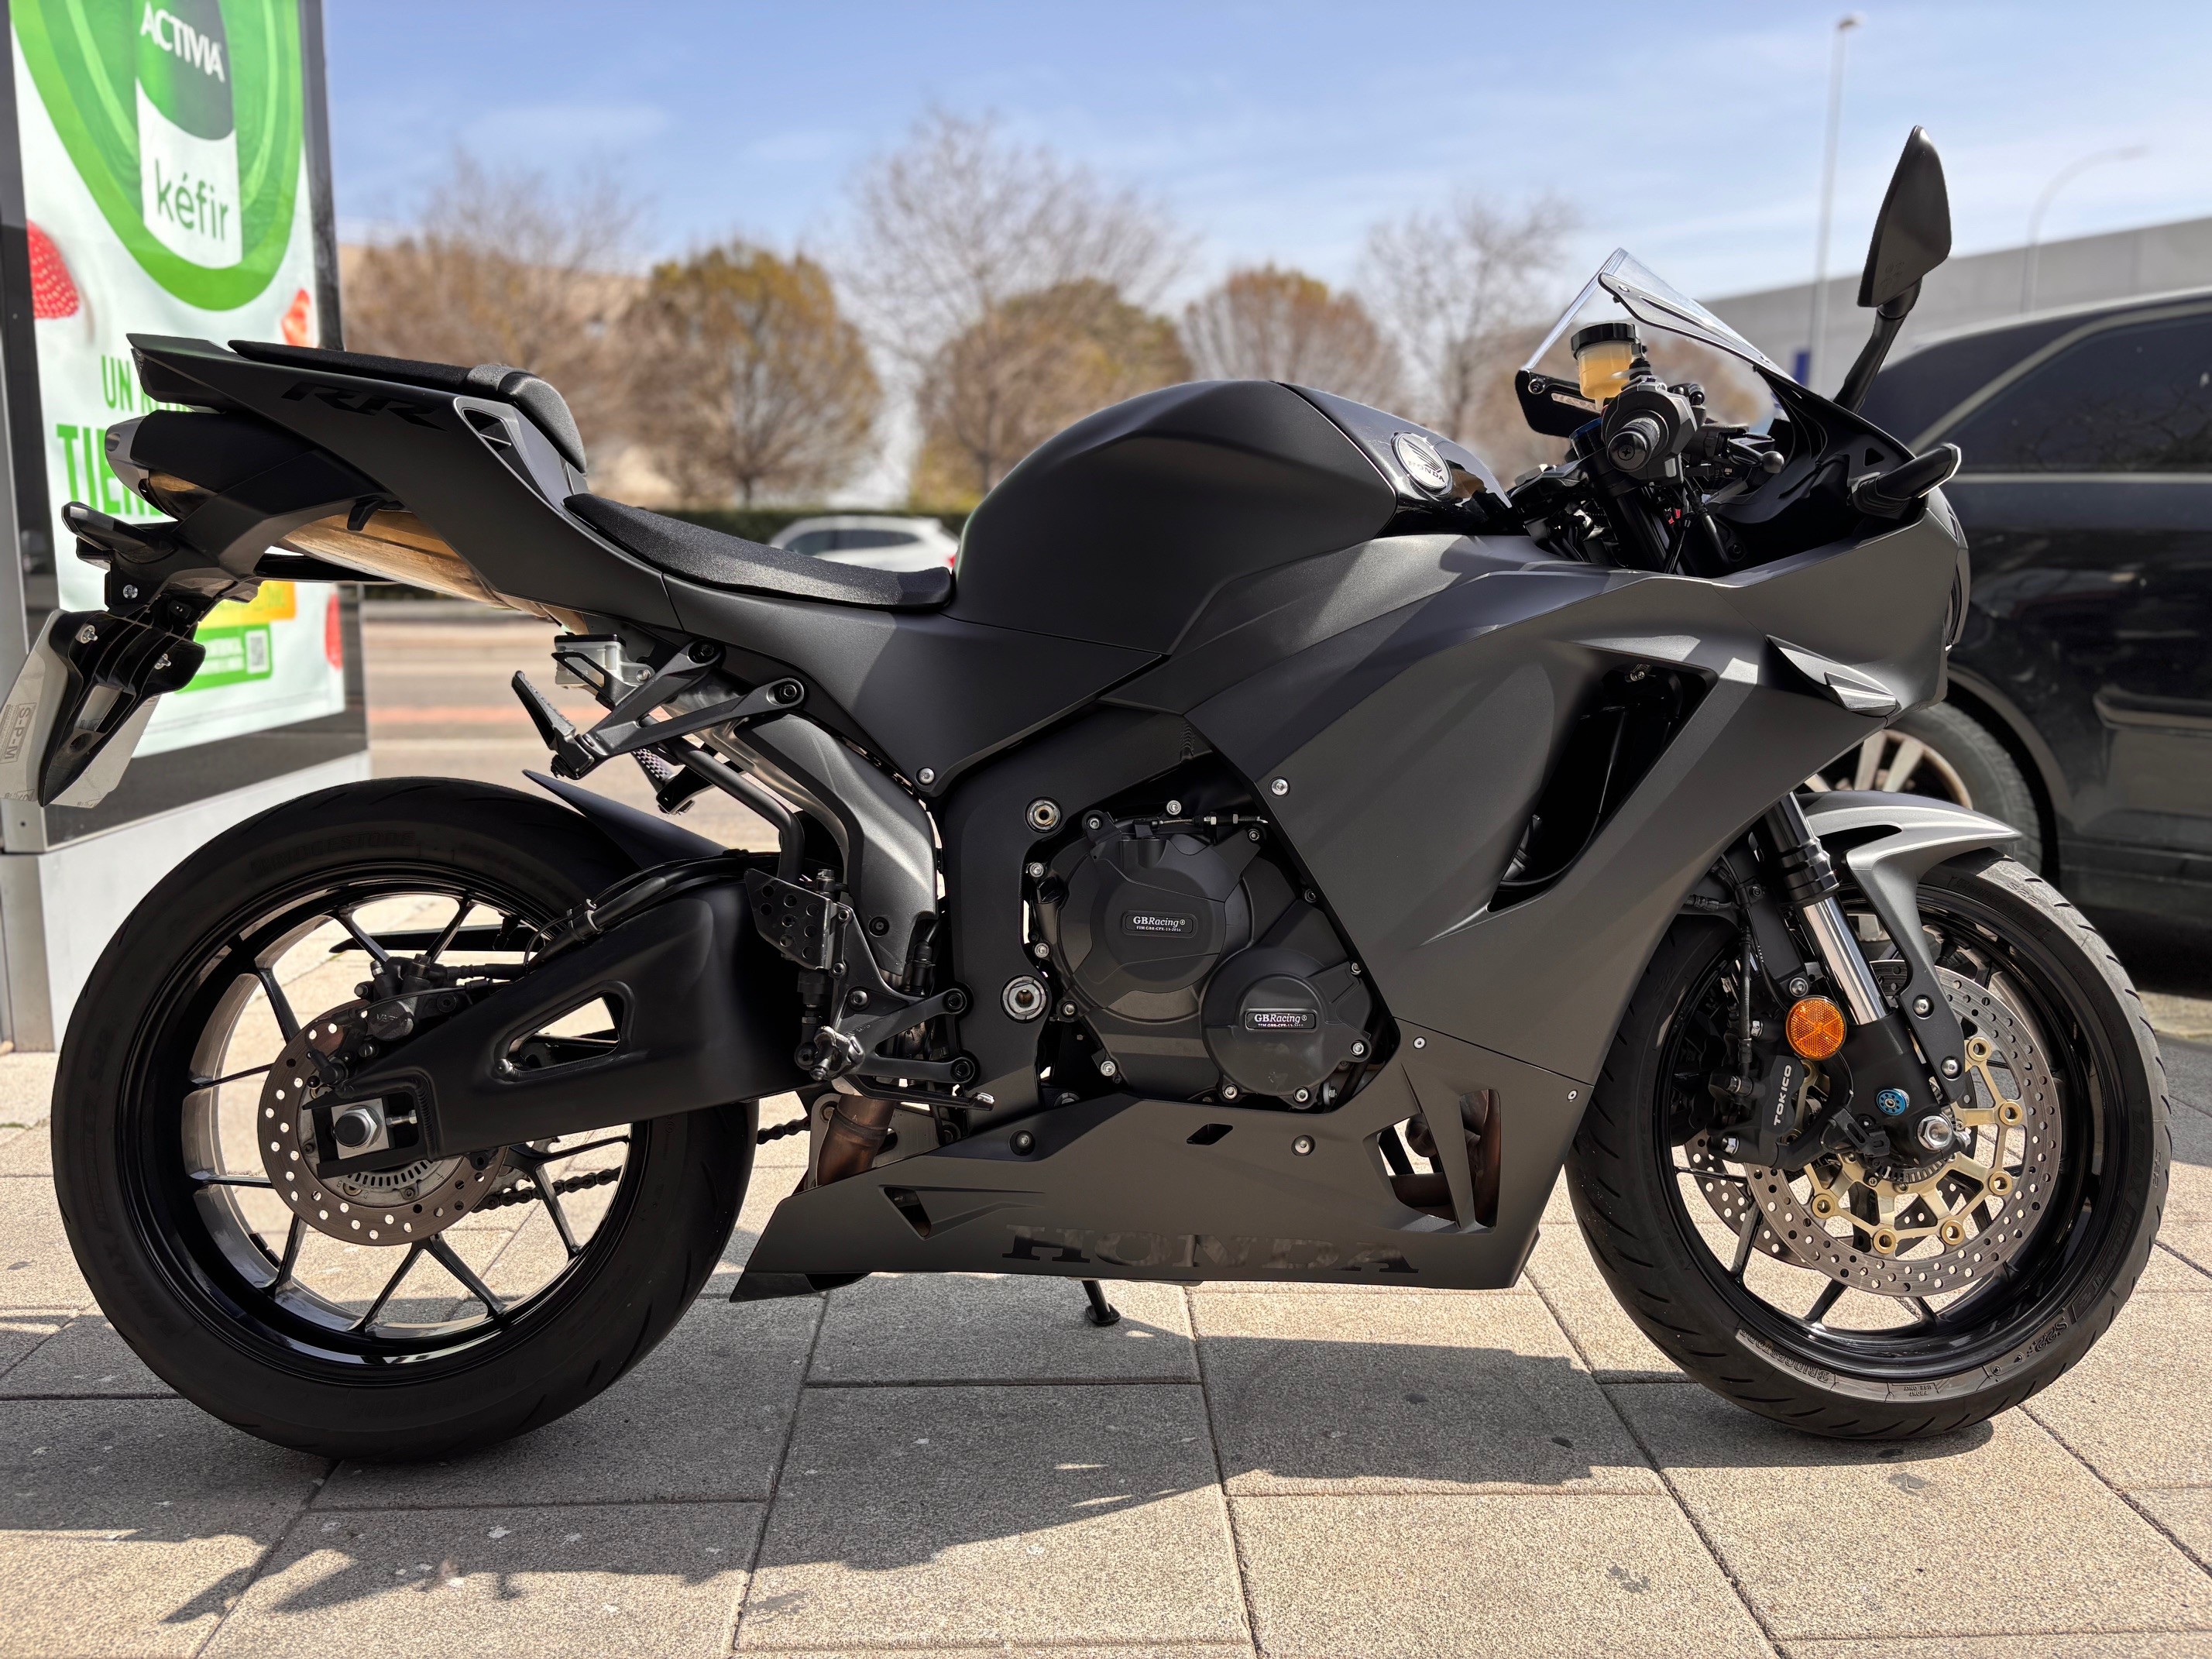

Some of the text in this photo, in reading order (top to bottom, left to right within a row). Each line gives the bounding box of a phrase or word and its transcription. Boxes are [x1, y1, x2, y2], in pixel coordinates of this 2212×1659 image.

[140, 0, 225, 83] ACTIVIA
[155, 158, 228, 242] kéfir
[101, 354, 132, 412] UN
[1407, 460, 1445, 483] HONDA
[1774, 1065, 1792, 1125] TOKICO
[1002, 1224, 1420, 1274] HONDA
[1739, 1330, 1832, 1384] BRIDGESTONE
